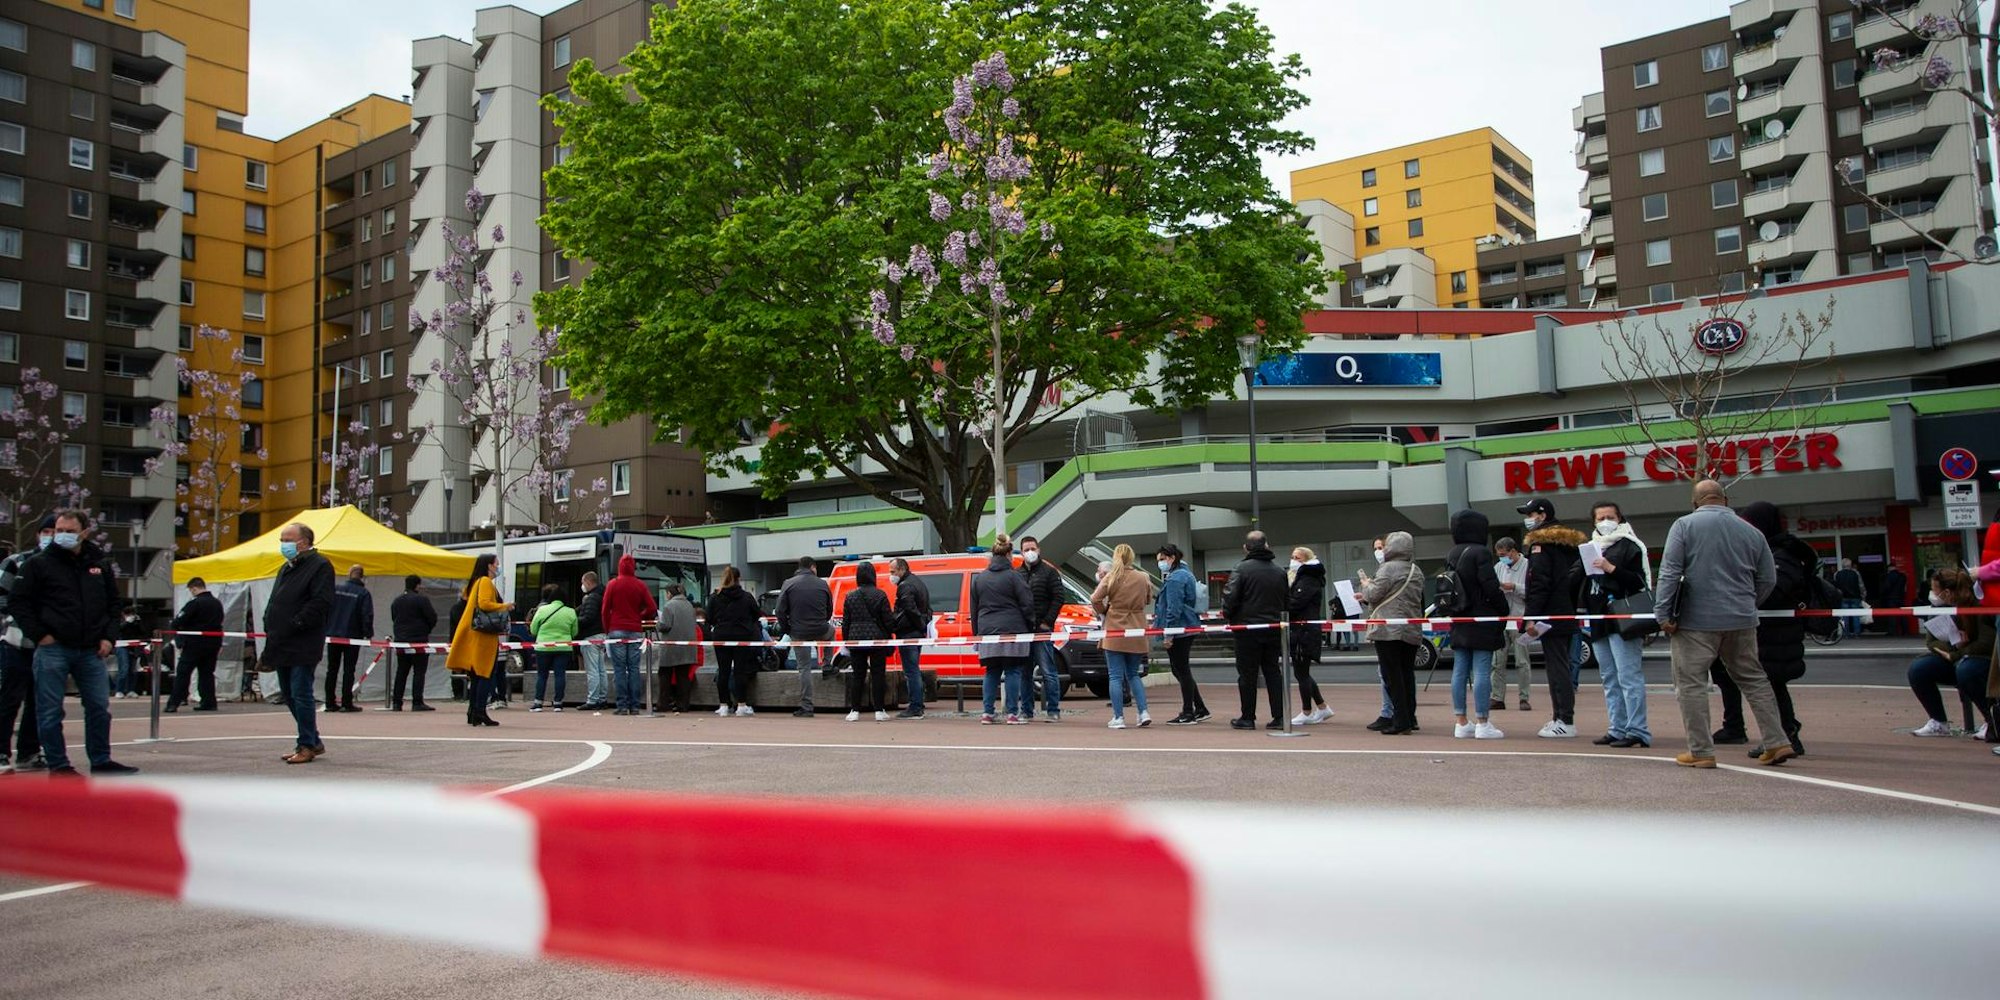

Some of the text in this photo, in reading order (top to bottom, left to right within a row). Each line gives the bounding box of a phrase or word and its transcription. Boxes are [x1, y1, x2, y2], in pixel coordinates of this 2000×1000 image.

[1503, 432, 1843, 495] REWE CENTER
[1797, 513, 1887, 532] Sparkasse
